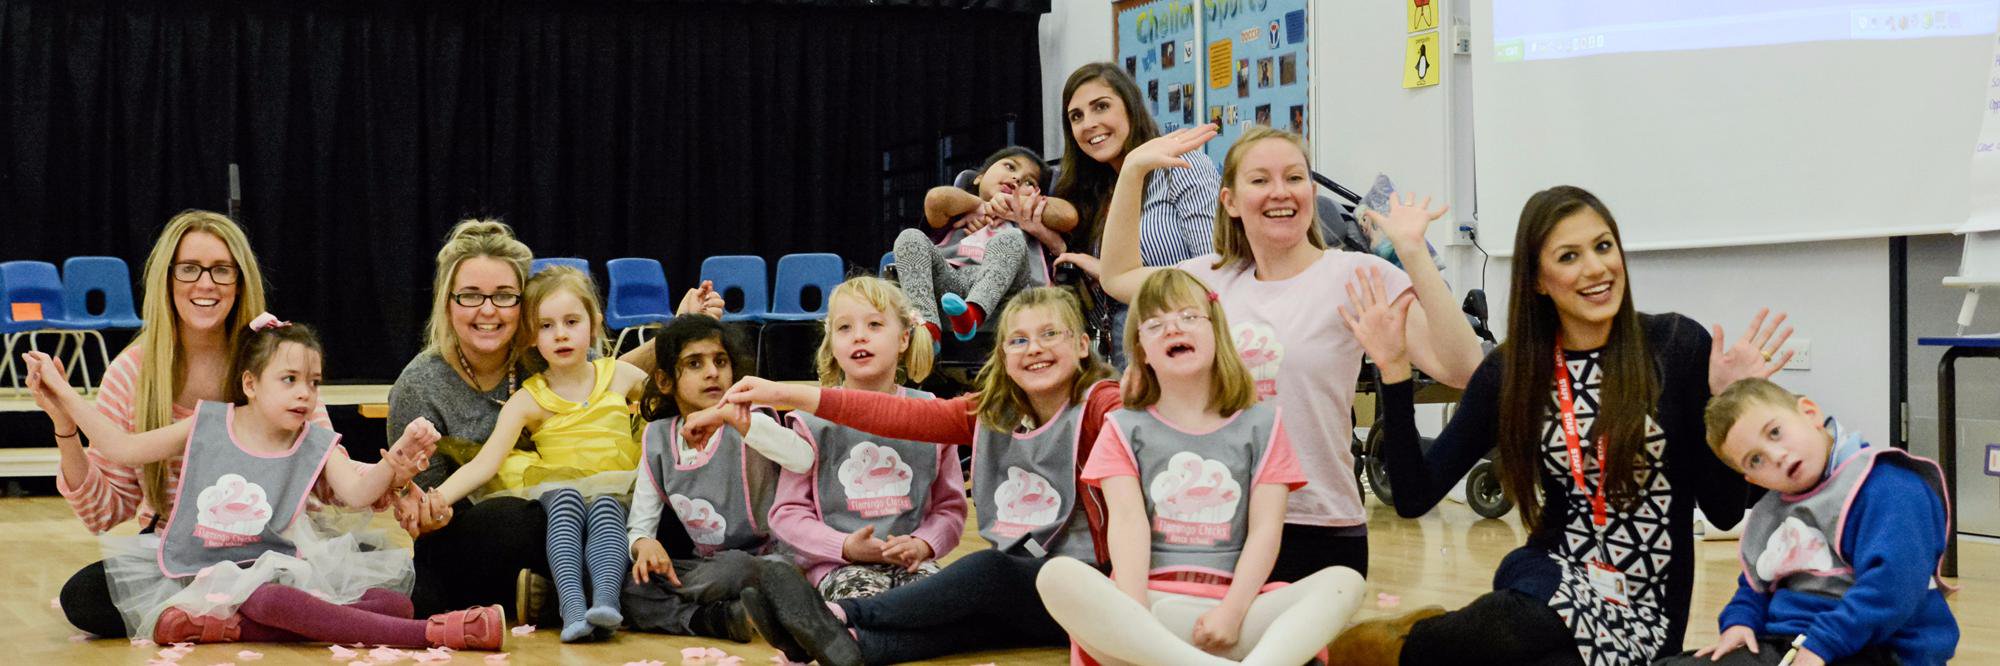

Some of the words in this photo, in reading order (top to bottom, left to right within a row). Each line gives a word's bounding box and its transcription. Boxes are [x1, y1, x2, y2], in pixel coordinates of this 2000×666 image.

[1136, 3, 1194, 44] Chello
[1558, 378, 1570, 400] STAFF
[1564, 412, 1576, 436] STAFF
[1570, 448, 1583, 473] STAFF
[198, 527, 230, 542] Flamingo
[1160, 520, 1197, 535] Flamingo
[1199, 524, 1227, 536] Chicks
